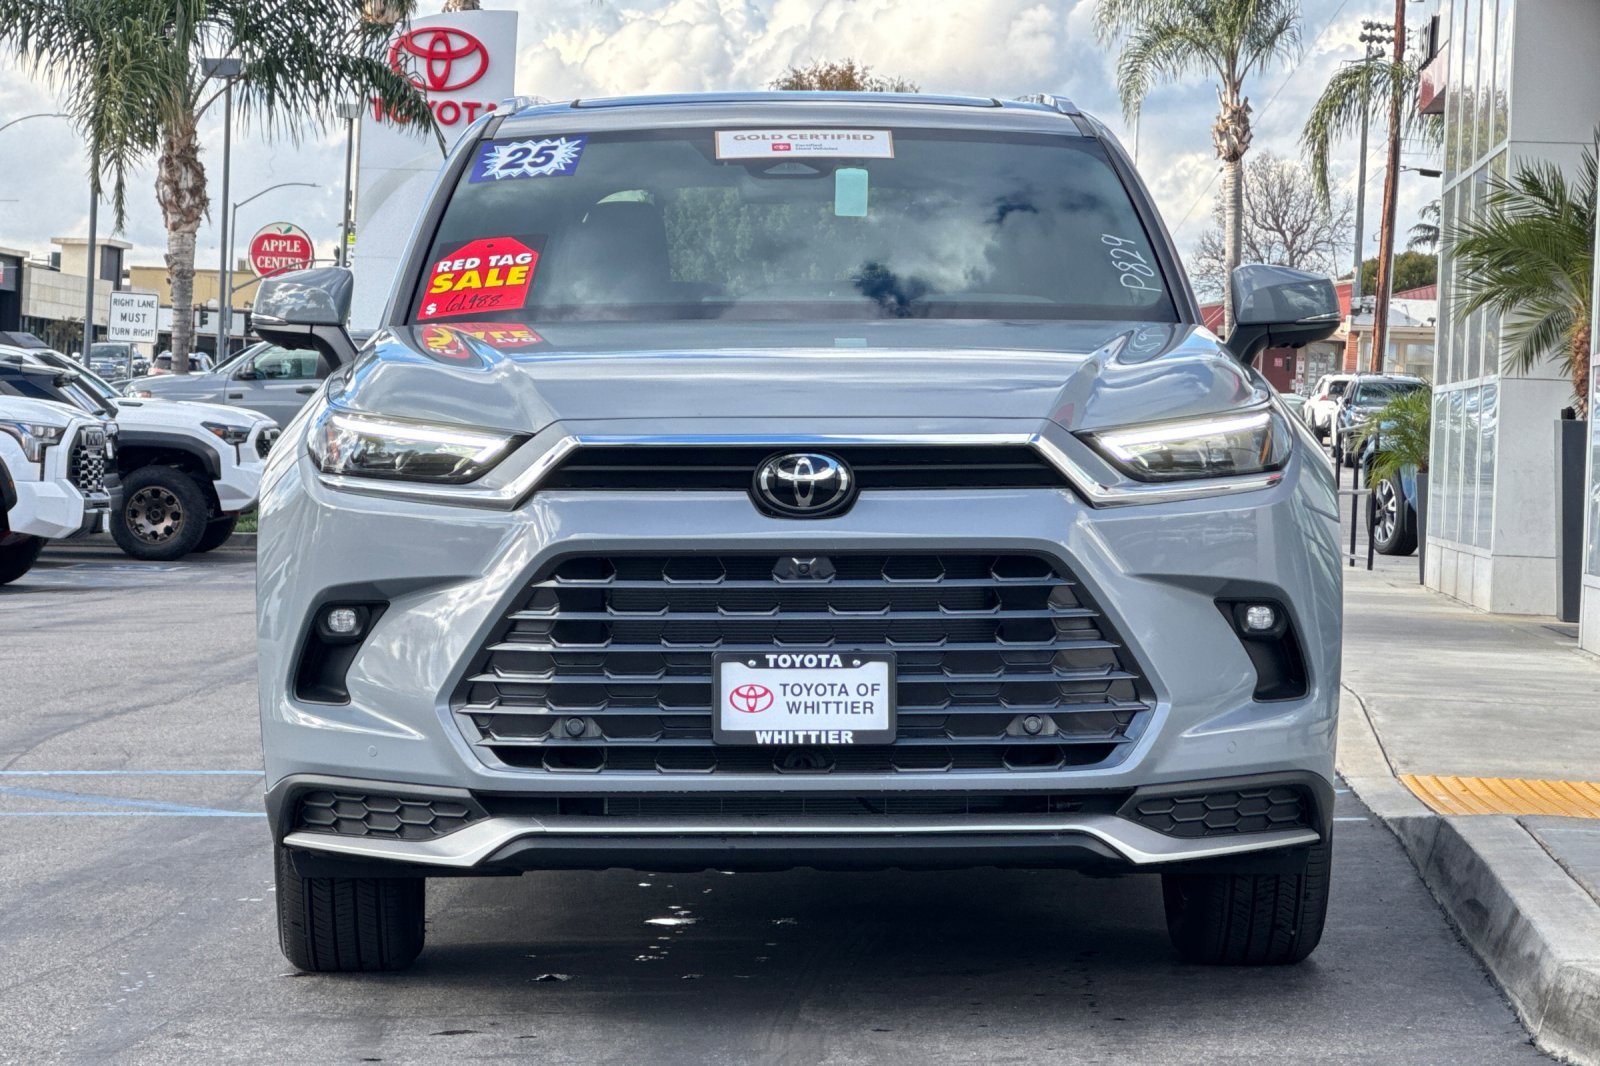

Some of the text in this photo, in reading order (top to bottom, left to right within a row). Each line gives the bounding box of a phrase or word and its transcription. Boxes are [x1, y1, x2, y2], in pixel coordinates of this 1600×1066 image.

[500, 144, 559, 170] 25
[262, 240, 301, 253] APPLE
[257, 256, 304, 270] CENTER
[437, 253, 533, 272] RED TAG
[429, 265, 529, 293] SALE
[112, 297, 156, 308] RIGHT LANE
[425, 303, 437, 315] $
[120, 312, 147, 323] MUST
[111, 328, 154, 337] TURN RIGHT
[765, 654, 843, 668] TOYOTA
[779, 683, 881, 697] TOYOTA OF
[786, 701, 874, 714] WHITTIER
[755, 731, 854, 744] WHITTIER
